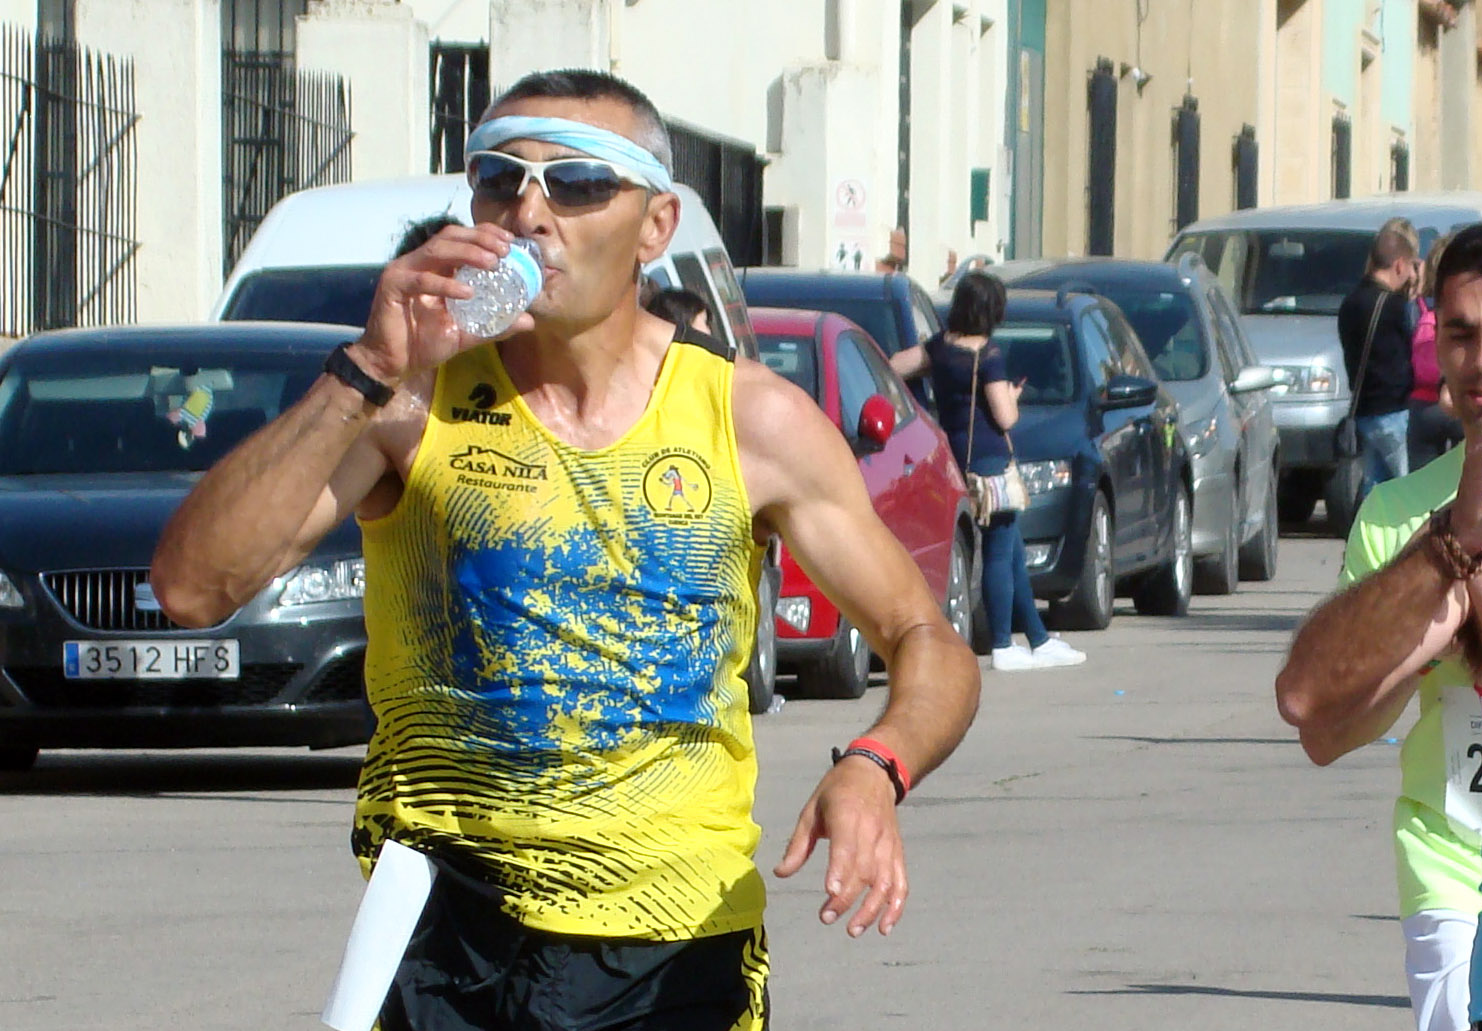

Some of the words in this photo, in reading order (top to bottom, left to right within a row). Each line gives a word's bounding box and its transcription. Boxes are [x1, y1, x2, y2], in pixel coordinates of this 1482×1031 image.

[451, 407, 512, 426] VIATOR
[641, 452, 660, 468] CLUB
[661, 447, 671, 455] DE
[450, 458, 498, 476] CASA
[502, 465, 548, 480] NILA
[456, 474, 538, 493] Restaurante
[86, 646, 161, 673] 3512
[174, 645, 229, 672] HFS
